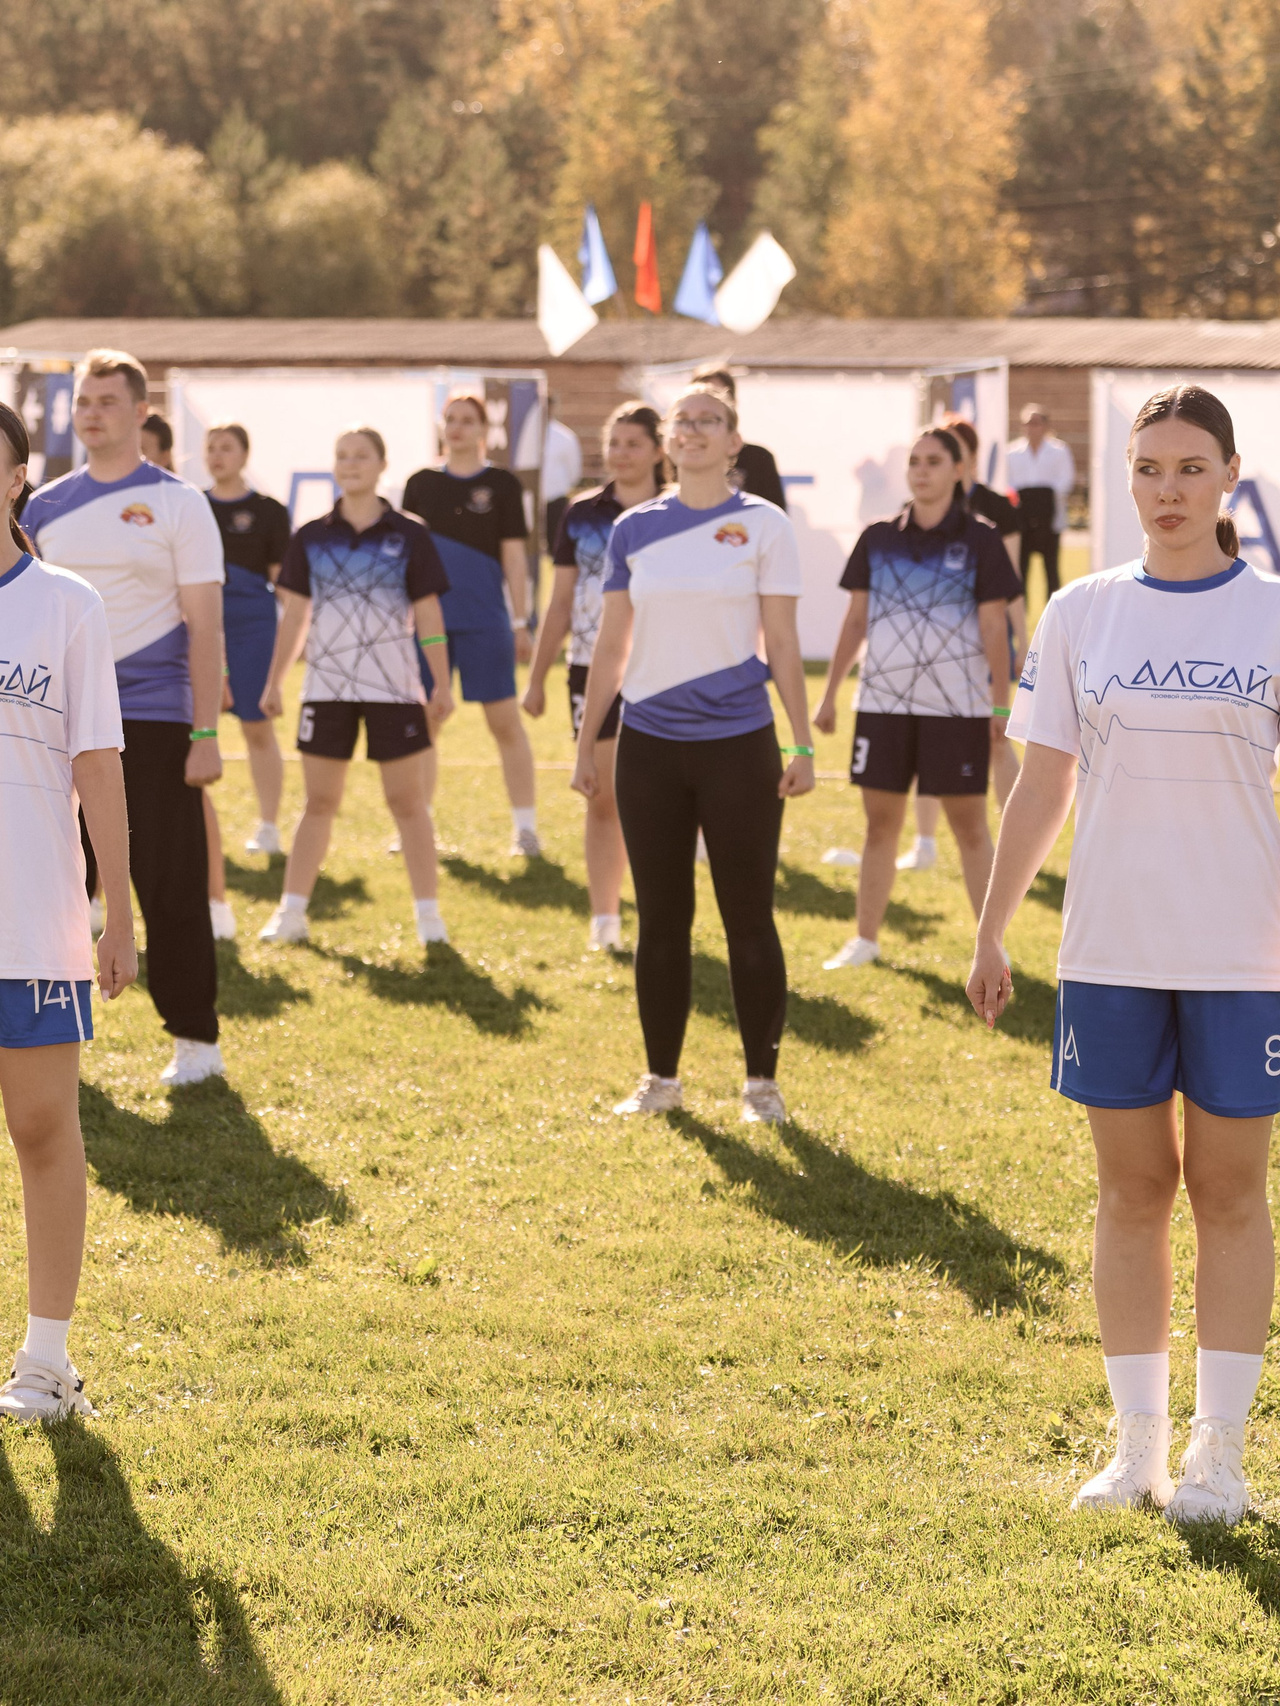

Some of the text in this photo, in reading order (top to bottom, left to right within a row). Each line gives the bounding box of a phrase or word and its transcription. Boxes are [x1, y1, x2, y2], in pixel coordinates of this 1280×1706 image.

[1131, 659, 1273, 701] АЛТАЙ
[299, 706, 316, 742] 6
[852, 736, 870, 774] 3
[27, 979, 70, 1014] 14
